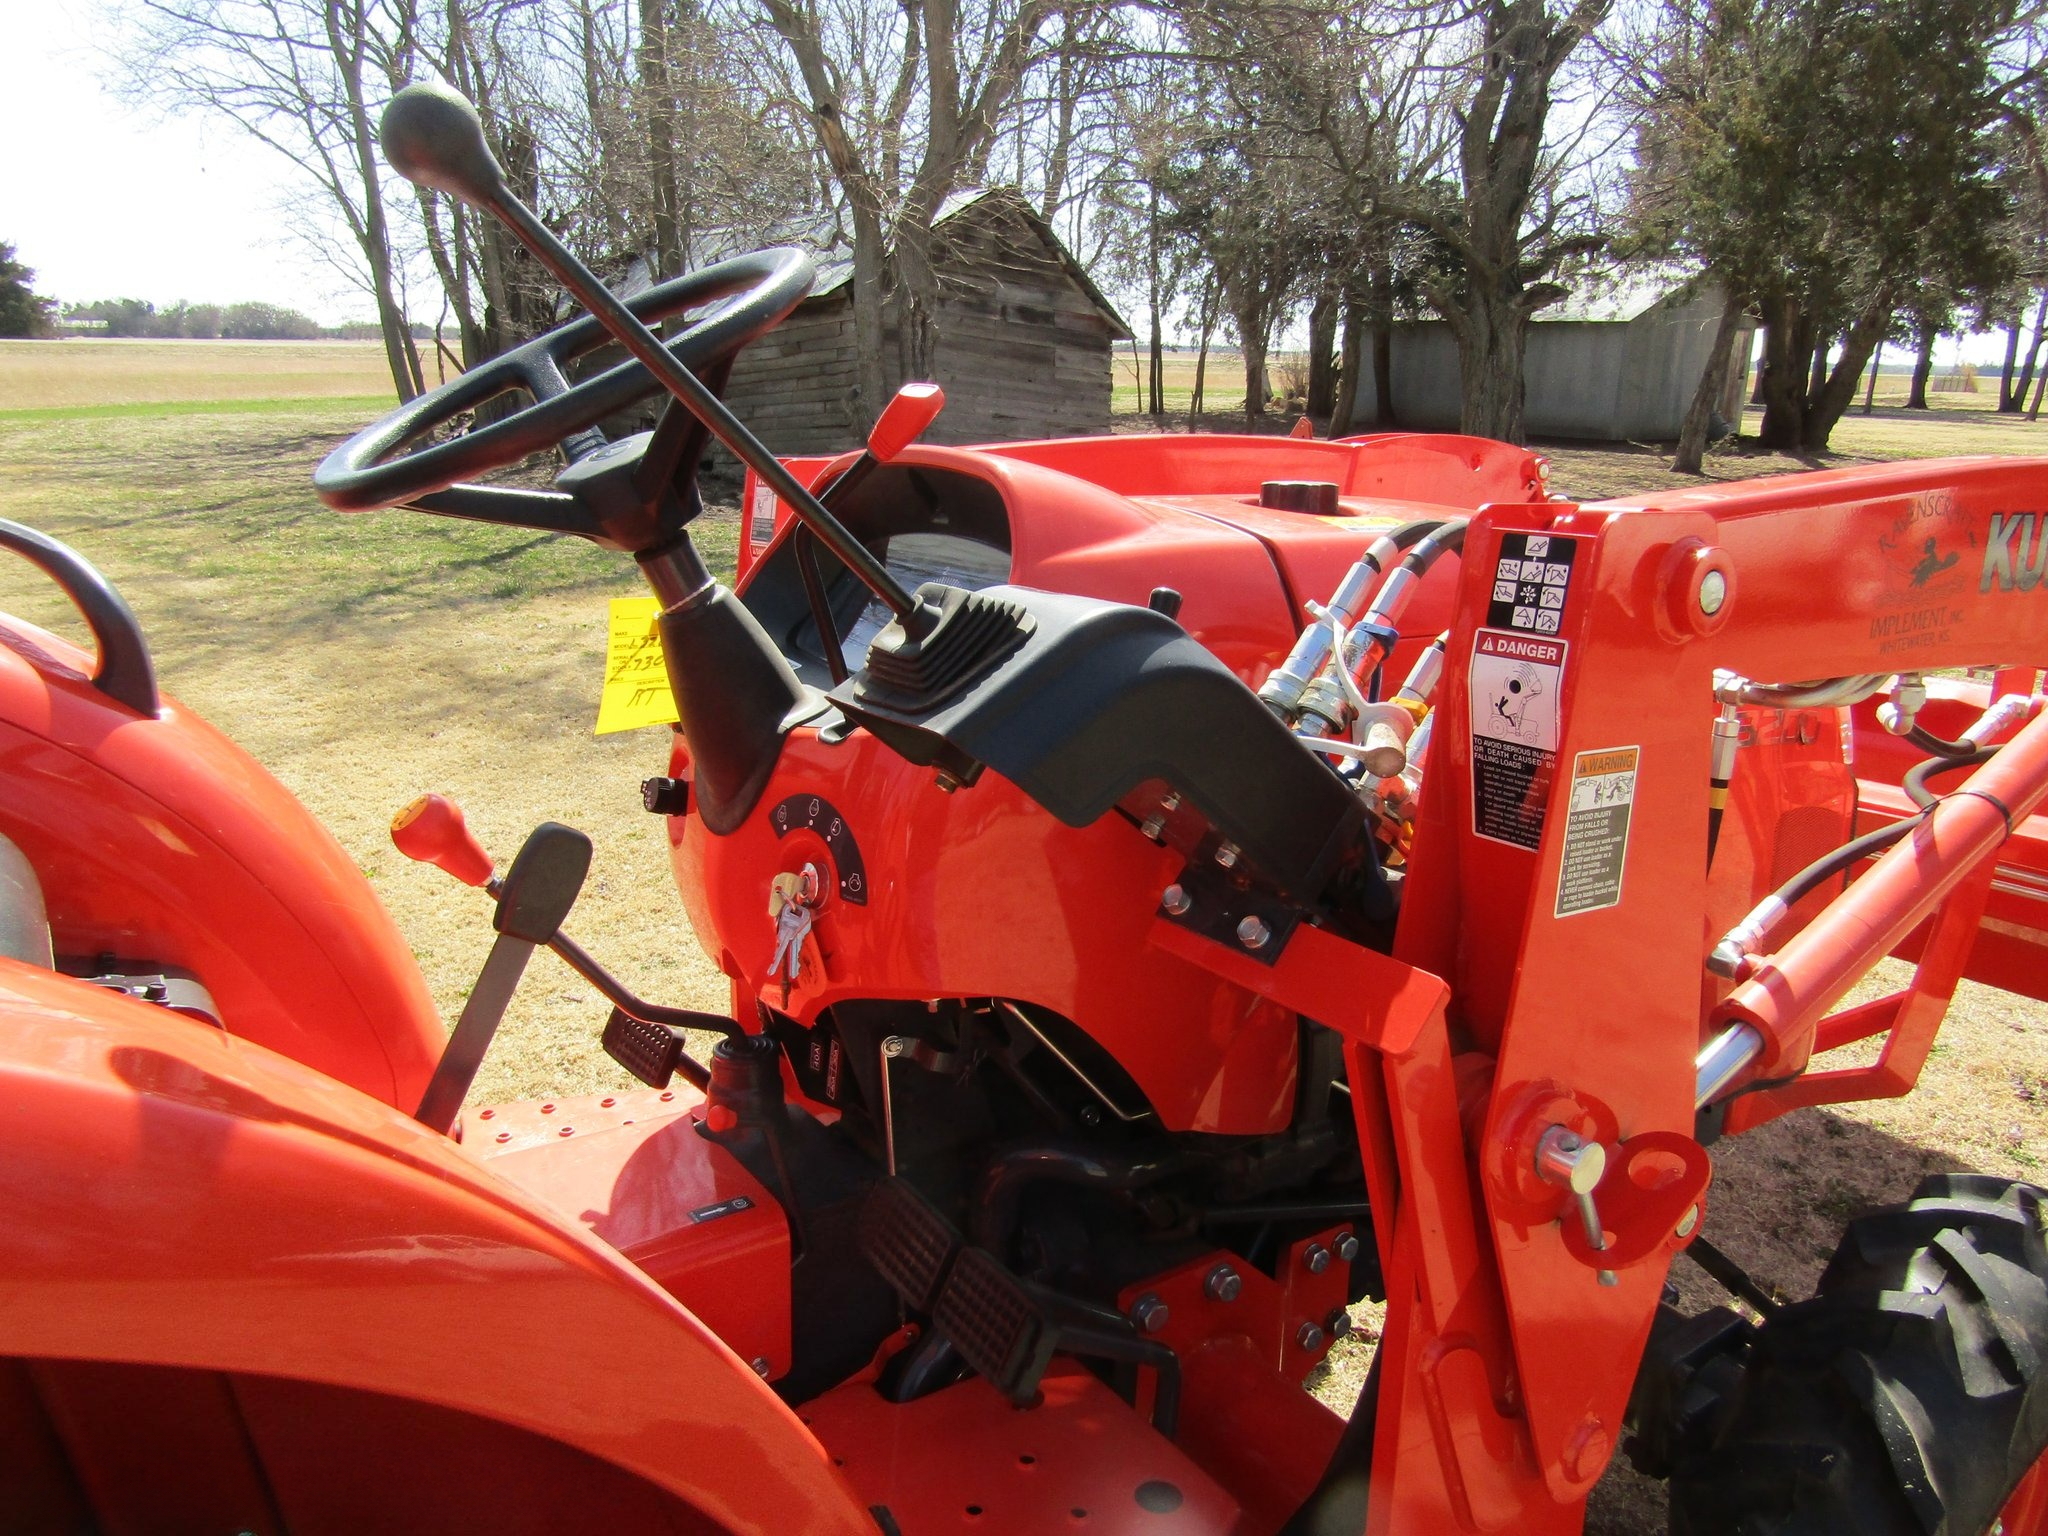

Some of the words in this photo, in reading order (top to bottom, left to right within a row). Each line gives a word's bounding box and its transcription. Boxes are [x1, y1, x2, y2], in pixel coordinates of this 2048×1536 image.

[1979, 511, 2048, 594] KU
[1496, 640, 1557, 660] DANGER
[1474, 737, 1482, 746] TO
[1484, 739, 1501, 750] AVOID
[1503, 743, 1531, 756] SERIOUS
[1532, 750, 1556, 762] INJURY
[1474, 745, 1484, 754] OR
[1487, 748, 1509, 759] DEATH
[1513, 753, 1542, 767] CAUSED
[1545, 761, 1555, 770] BY
[1474, 752, 1499, 764] FALLING
[1590, 754, 1633, 772] WARNING
[1569, 822, 1585, 832] FROM
[1584, 820, 1600, 829] FALLS
[1600, 819, 1609, 827] OR
[1578, 813, 1594, 821] AVOID
